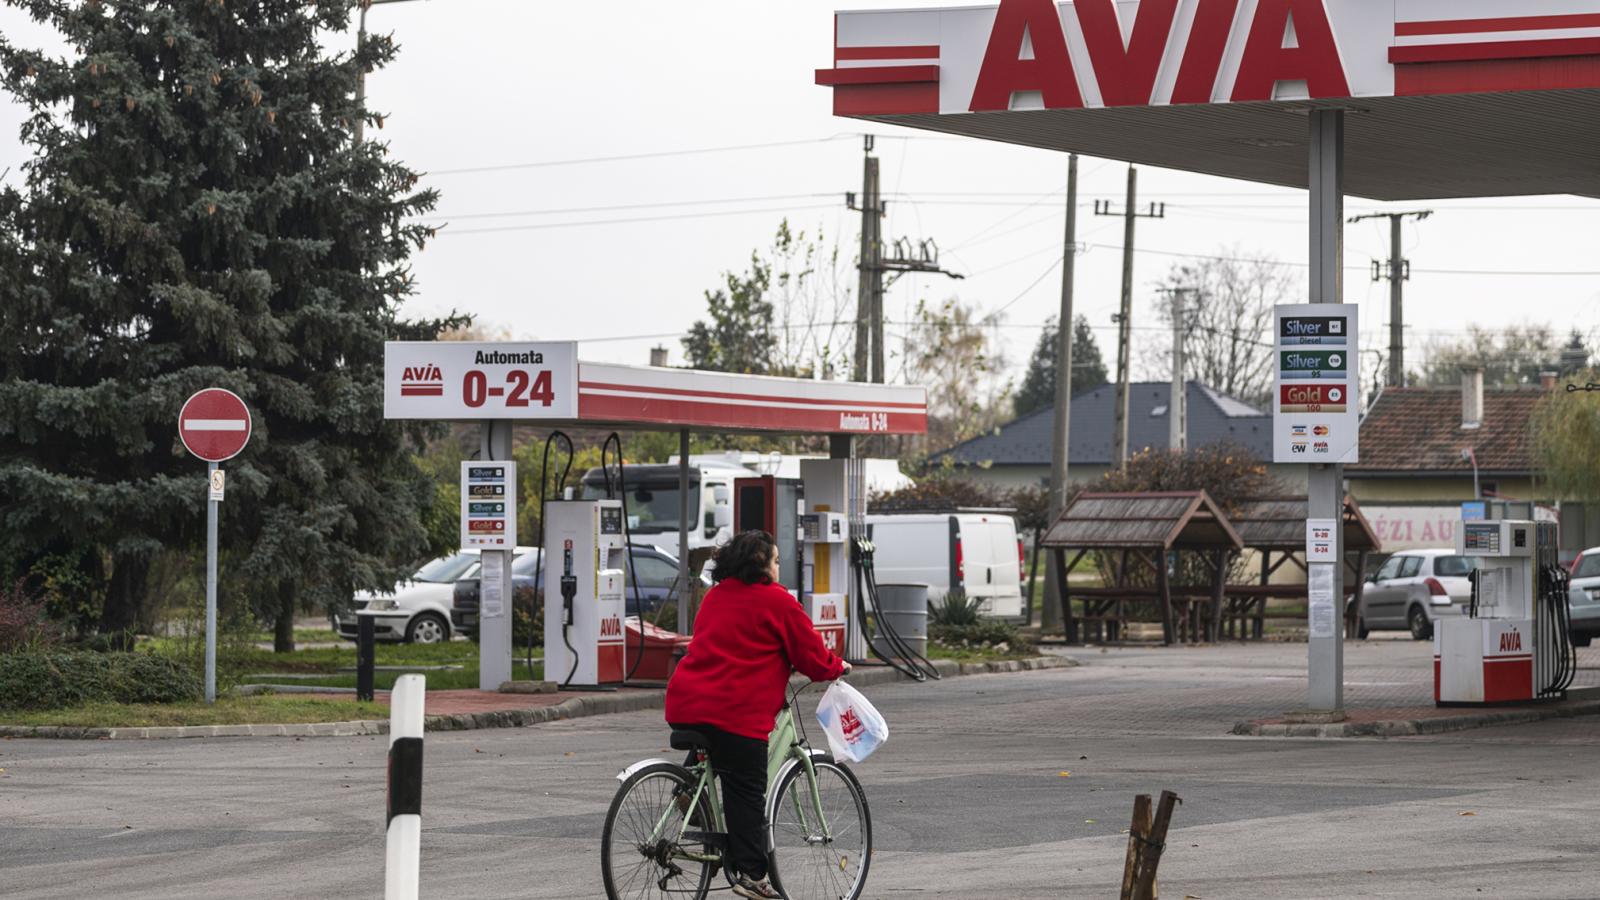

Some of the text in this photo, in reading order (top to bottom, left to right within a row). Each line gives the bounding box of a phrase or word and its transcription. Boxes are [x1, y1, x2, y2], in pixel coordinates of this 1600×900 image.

[1287, 320, 1322, 335] Silver
[1300, 337, 1322, 345] Diesel
[474, 350, 544, 365] Automata
[1287, 354, 1322, 369] Silver
[1311, 369, 1322, 378] 95
[462, 369, 555, 408] 0-24
[1288, 387, 1321, 403] Gold
[1307, 404, 1321, 413] 100
[840, 412, 888, 431] Automata 0-24
[474, 486, 493, 496] Gold
[473, 521, 493, 530] Gold
[1373, 514, 1413, 541] ÉZI
